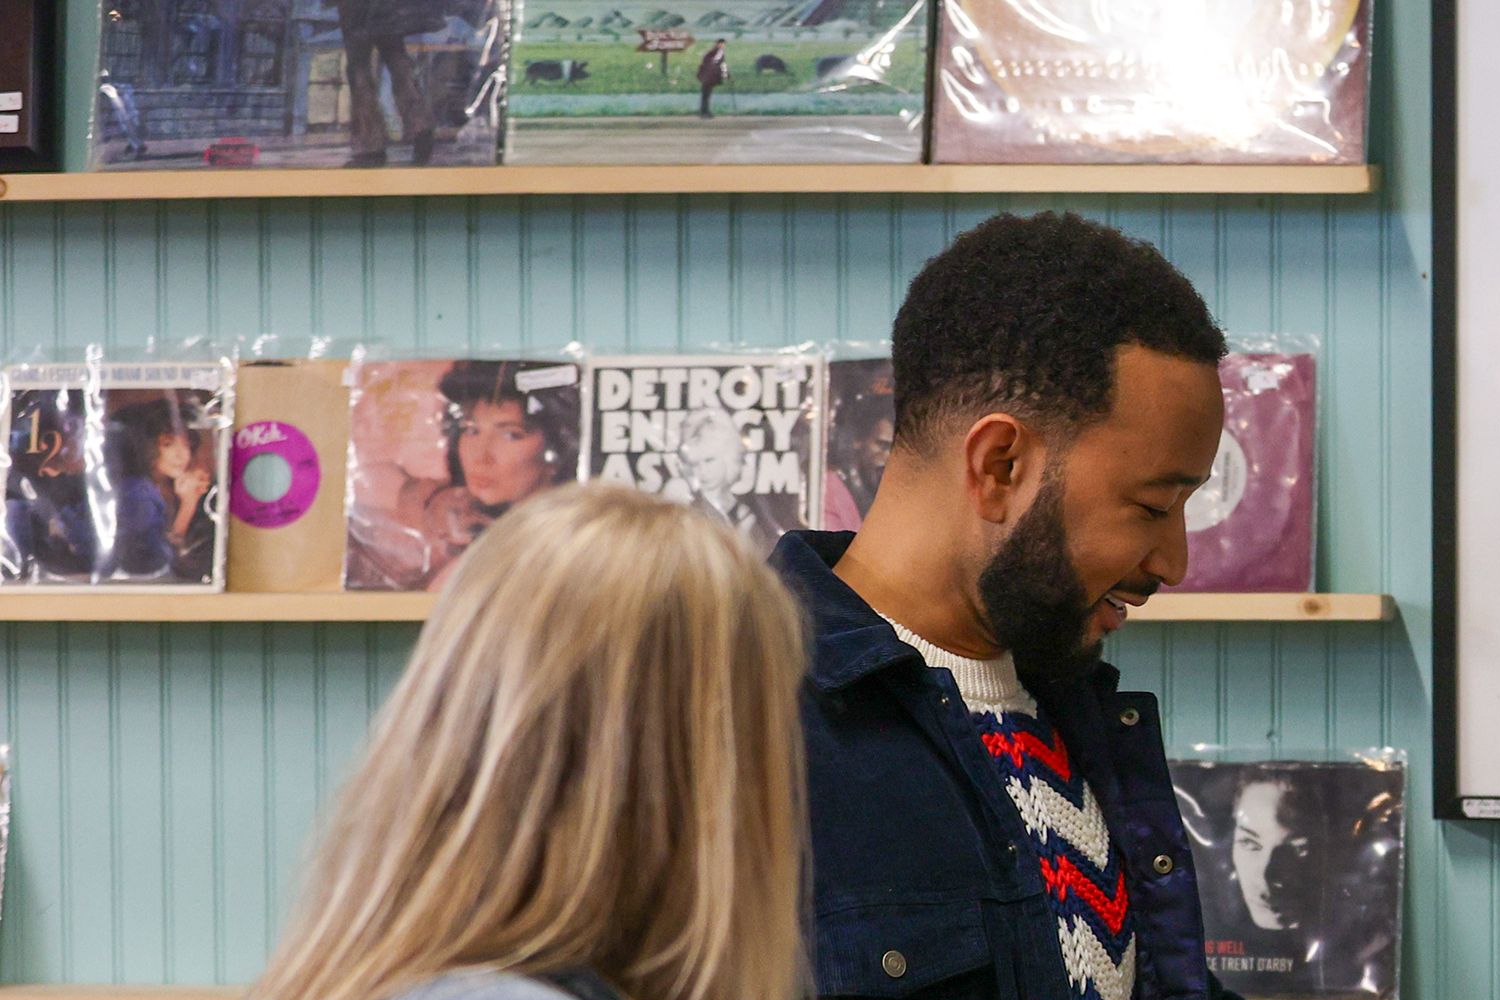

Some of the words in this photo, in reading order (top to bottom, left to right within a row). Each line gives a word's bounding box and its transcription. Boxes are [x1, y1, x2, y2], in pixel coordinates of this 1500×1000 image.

[598, 366, 808, 411] DETROIT
[600, 409, 801, 452] ENGY
[600, 451, 801, 495] ASUM
[1217, 940, 1245, 955] WELL
[1221, 956, 1255, 970] TRENT
